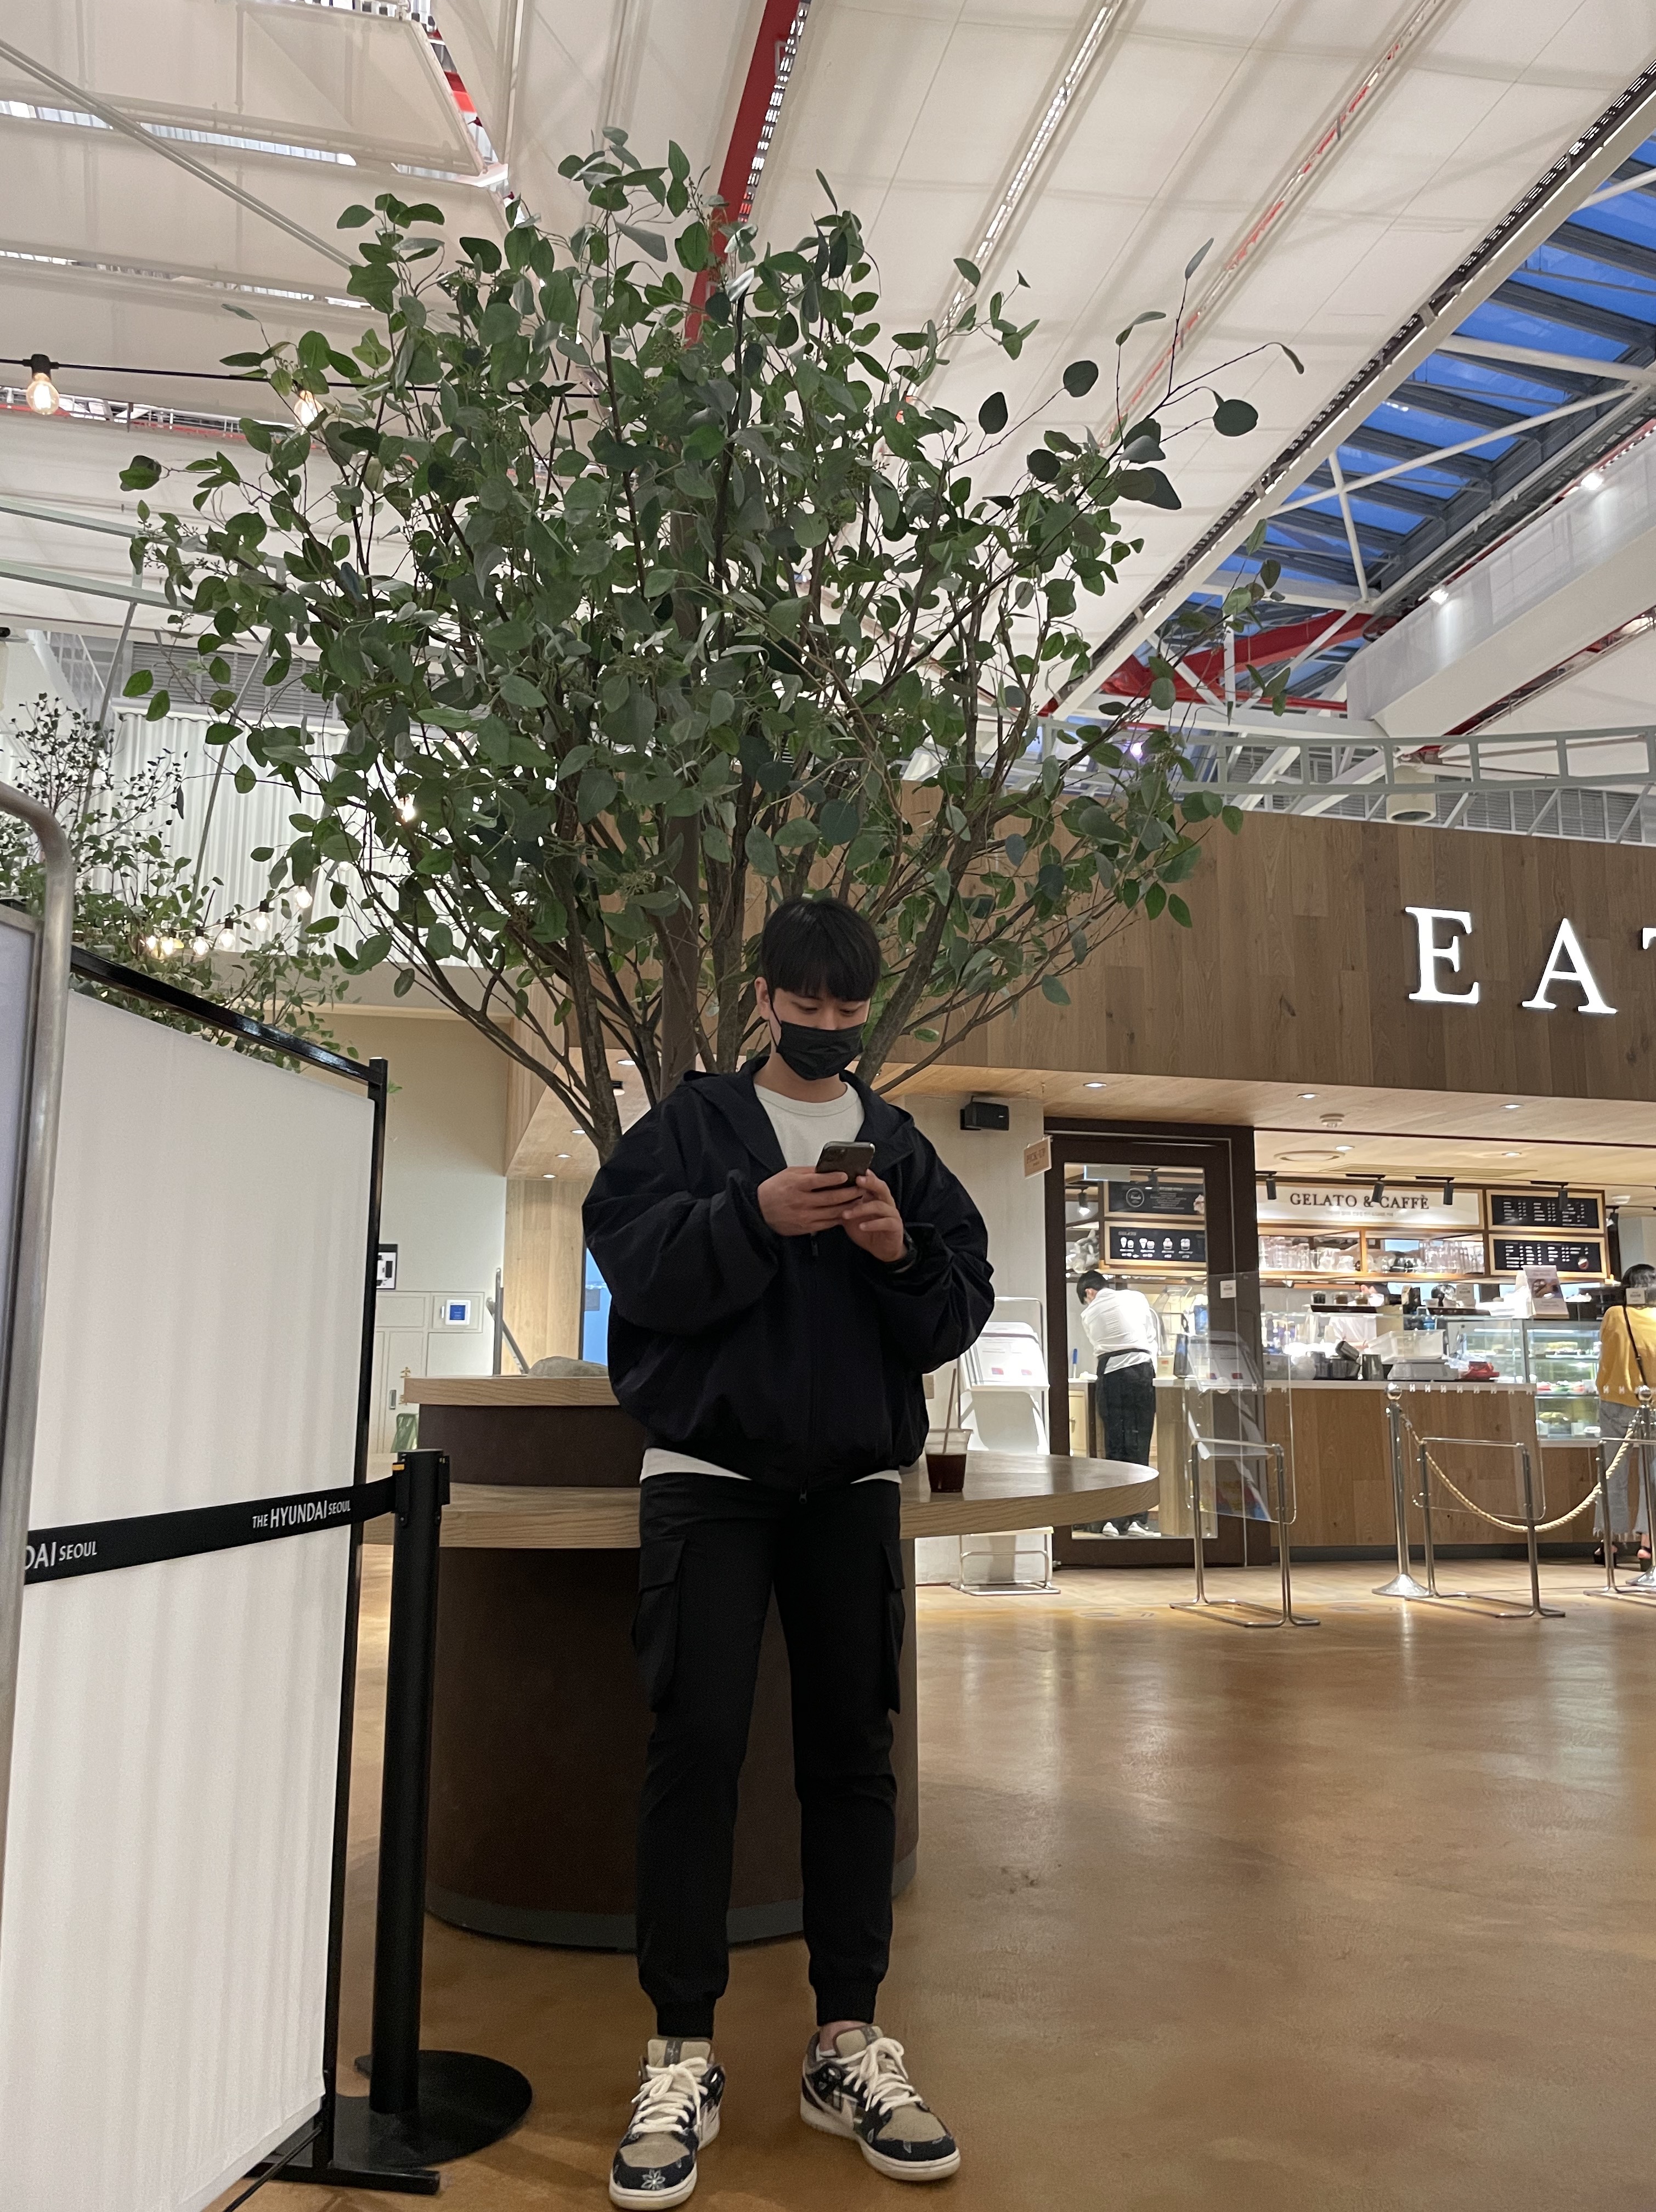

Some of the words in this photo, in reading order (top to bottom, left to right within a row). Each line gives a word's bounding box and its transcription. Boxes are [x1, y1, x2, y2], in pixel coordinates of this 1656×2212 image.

[1290, 1193, 1358, 1207] GELATO
[1363, 1195, 1375, 1208] &
[252, 1514, 269, 1528] THE
[270, 1500, 327, 1528] HYUNDAI
[328, 1500, 351, 1515] SEOUL
[59, 1541, 98, 1561] SEOUL
